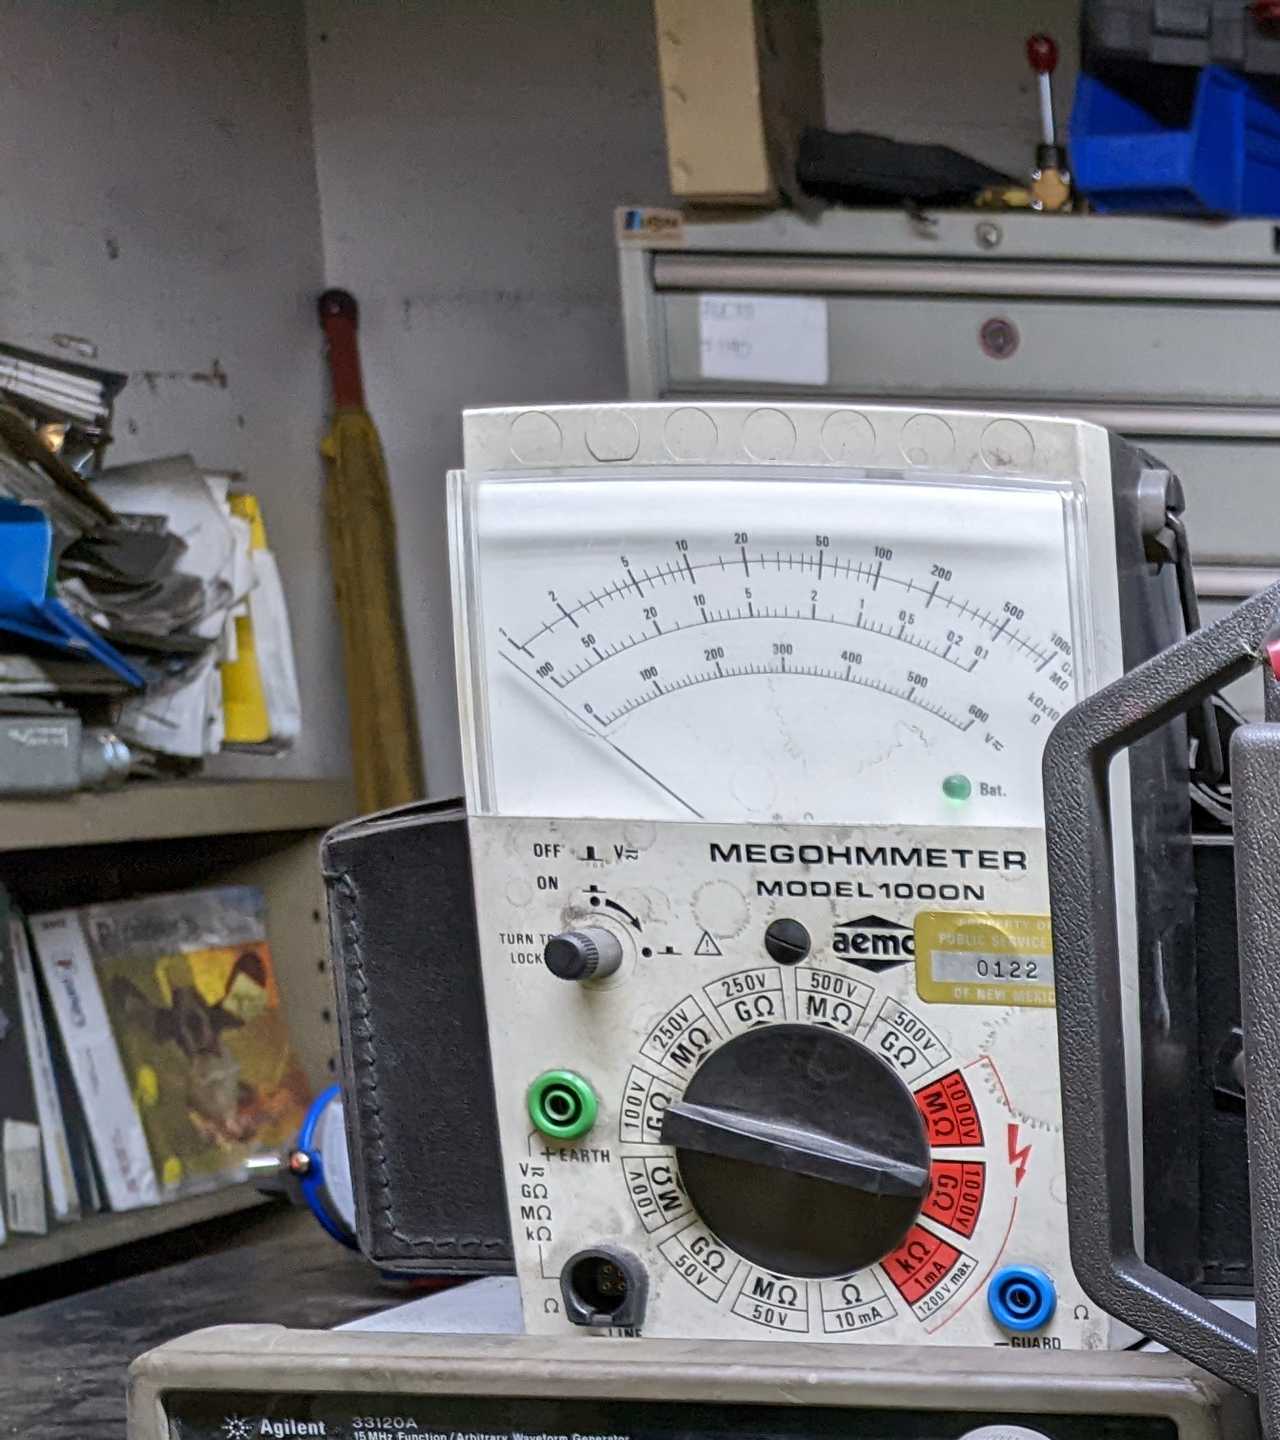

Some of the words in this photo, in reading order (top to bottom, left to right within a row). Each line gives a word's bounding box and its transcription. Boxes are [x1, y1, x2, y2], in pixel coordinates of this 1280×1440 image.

[675, 539, 689, 552] 10
[734, 533, 748, 545] 20
[815, 535, 830, 548] 50
[873, 546, 893, 562] 100
[930, 565, 953, 582] 200
[1002, 601, 1025, 621] 500
[640, 665, 659, 682] 100
[704, 647, 725, 661] 200
[772, 643, 794, 656] 300
[840, 651, 863, 666] 400
[906, 671, 928, 688] 500
[968, 704, 989, 724] 600
[979, 783, 1007, 797] Bat.
[533, 843, 561, 858] OFF
[710, 844, 1027, 871] MEGOHMMETER
[536, 875, 559, 890] ON
[756, 880, 873, 898] MODEL
[877, 882, 985, 901] 1000N
[499, 933, 540, 945] TURN
[510, 952, 544, 965] LOCK
[977, 960, 1039, 979] 0122
[721, 975, 767, 996] 250V
[810, 974, 856, 996] 500V
[624, 1079, 646, 1131] 100V
[946, 1075, 979, 1140] 1000V
[955, 1170, 981, 1230] 1000V
[752, 1305, 789, 1324] 50V
[260, 1418, 327, 1437] Agilent
[352, 1416, 418, 1429] 33120A
